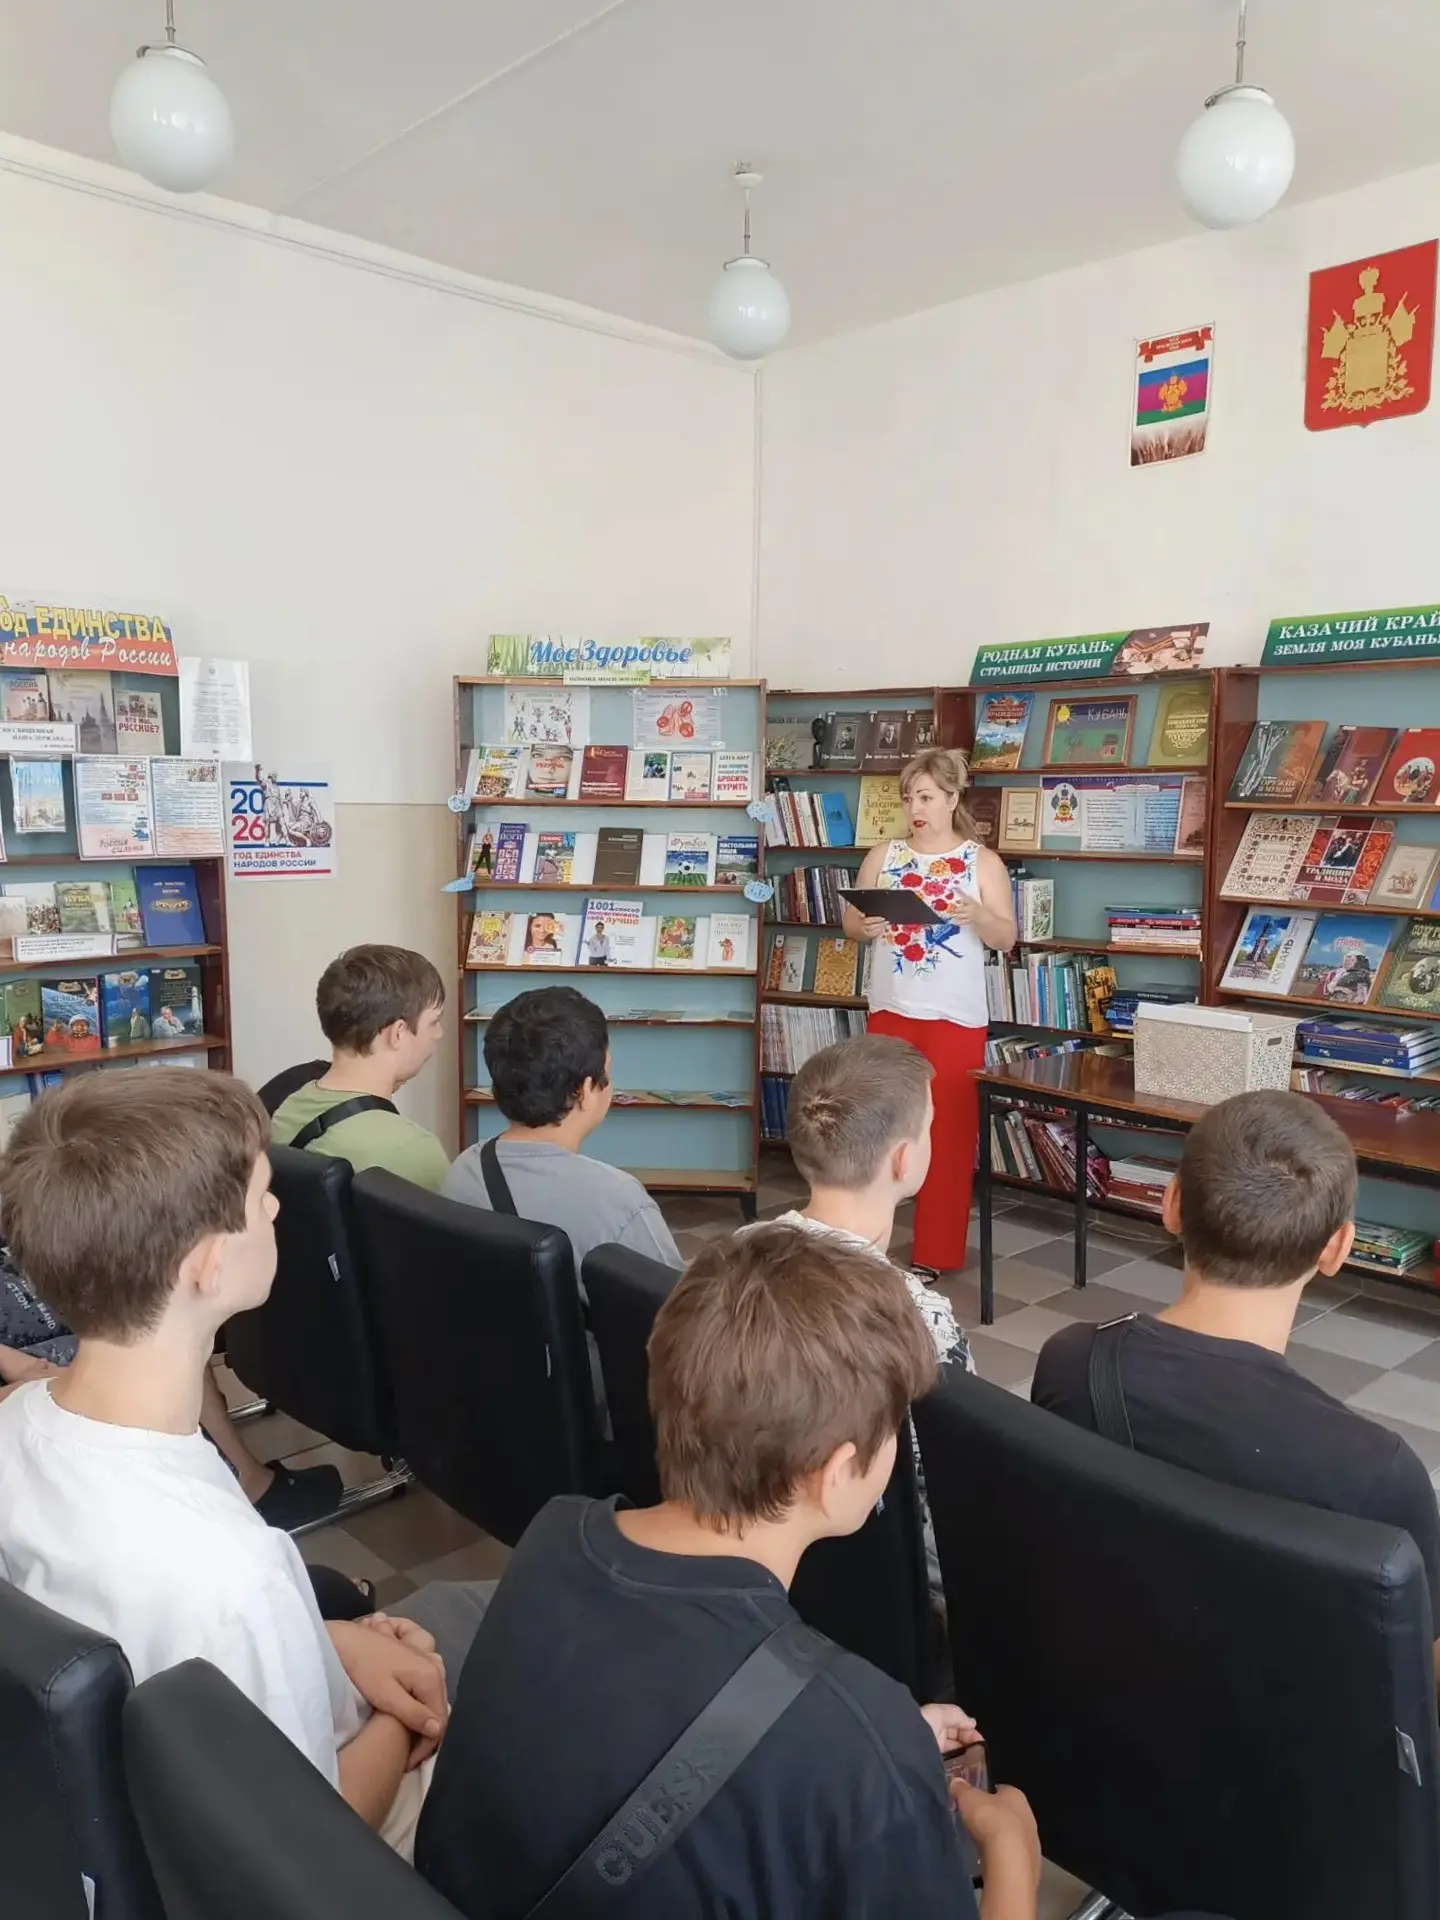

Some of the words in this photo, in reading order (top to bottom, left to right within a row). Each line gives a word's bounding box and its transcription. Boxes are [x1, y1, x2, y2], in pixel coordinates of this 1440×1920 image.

[35, 606, 167, 643] ЕДИНСТВА
[1279, 615, 1378, 639] КАЗАЧИЙ
[1383, 610, 1440, 631] КРАЙ
[4, 636, 91, 667] народов
[98, 636, 172, 666] России
[530, 640, 578, 664] Мое
[579, 639, 692, 668] Здоровье
[980, 647, 1041, 664] РОДНАЯ
[1045, 639, 1114, 658] КУБАНЬ:
[1273, 644, 1326, 656] ЗЕМЛЯ
[1330, 638, 1365, 652] МОЯ
[980, 663, 1042, 677] СТРАНИЦЫ
[1046, 658, 1101, 672] ИСТОРИИ
[1087, 706, 1127, 721] КУБАНЬ
[118, 722, 160, 734] РУССКИЕ?
[717, 783, 748, 792] КУРИТЬ
[231, 788, 265, 814] 20
[232, 815, 266, 841] 26
[233, 851, 252, 859] ГОД
[255, 851, 302, 859] ЕДИНСТВА
[233, 860, 277, 868] НАРОДОВ
[280, 859, 316, 867] РОССИИ
[589, 901, 615, 911] 1001
[1270, 938, 1294, 985] КУБАНЬ
